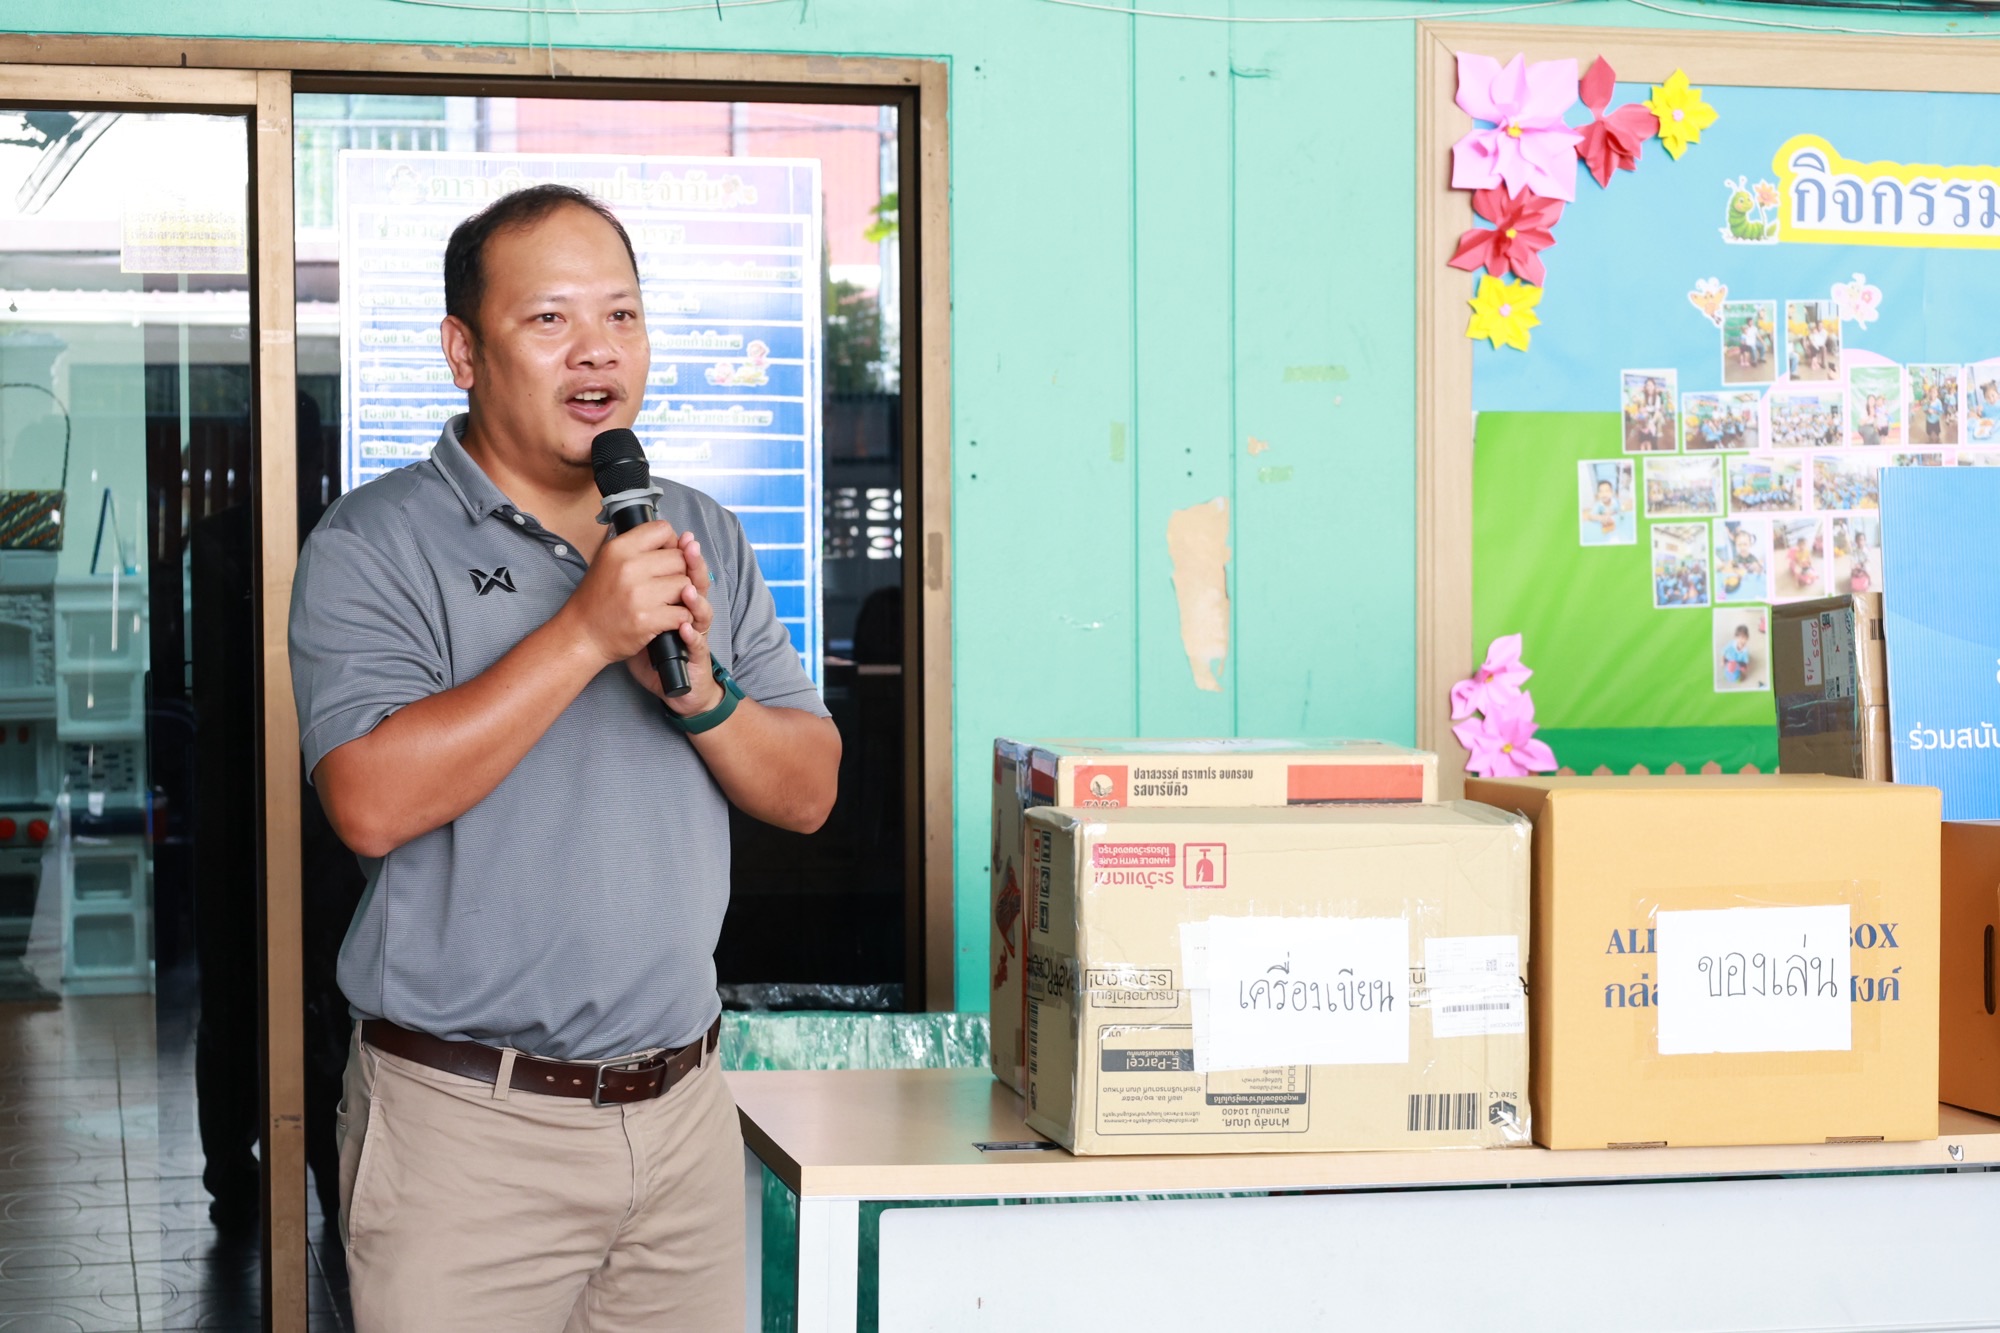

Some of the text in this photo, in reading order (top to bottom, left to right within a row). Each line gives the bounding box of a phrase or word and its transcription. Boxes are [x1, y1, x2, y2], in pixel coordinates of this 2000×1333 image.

[1793, 153, 2000, 228] กิจกรรม
[1133, 767, 1179, 780] ปลาสวรรค์
[1219, 768, 1254, 780] อบกรอบ
[1098, 857, 1170, 865] HANDLE WITH CARE
[1850, 923, 1899, 949] OX
[1698, 934, 1838, 997] ของเล่น
[1240, 952, 1395, 1012] เครื่องเขียน
[1126, 1057, 1180, 1070] E-Parcel
[1222, 1108, 1249, 1116] 10400
[1254, 1117, 1290, 1129] ฝากส่ง
